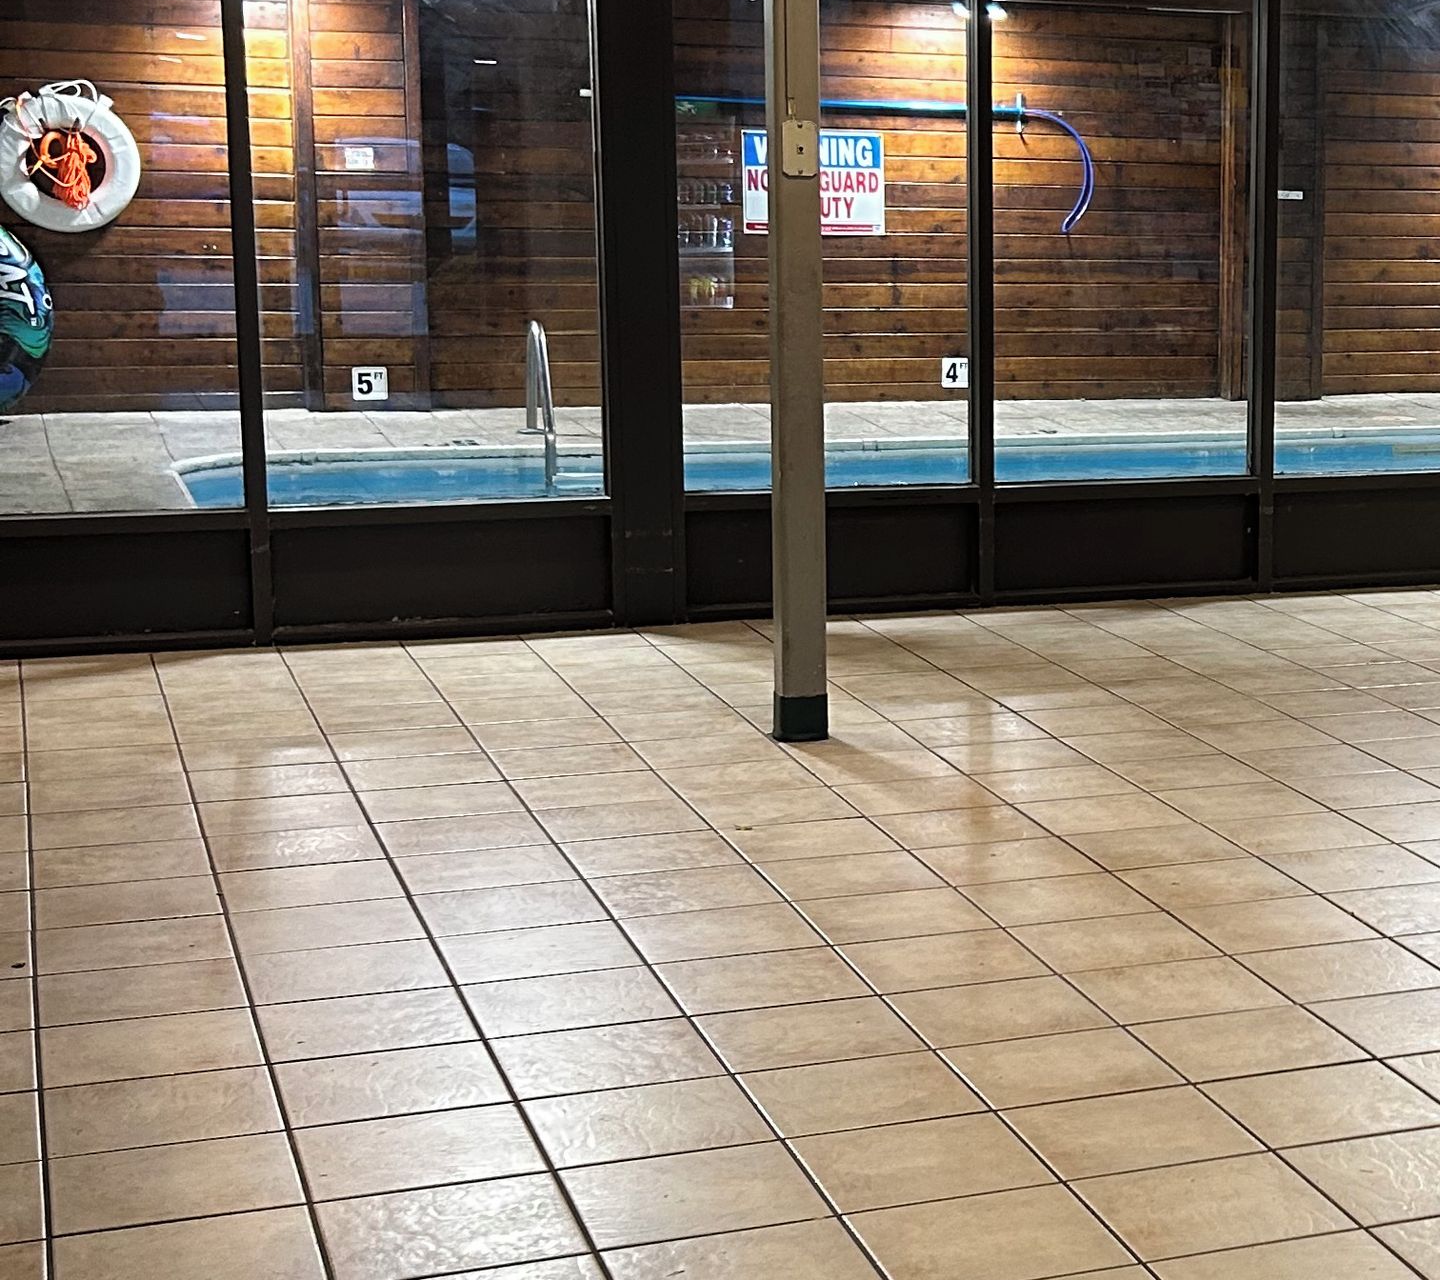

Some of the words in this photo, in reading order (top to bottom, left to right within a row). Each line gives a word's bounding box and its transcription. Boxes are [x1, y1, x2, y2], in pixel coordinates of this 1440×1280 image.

[357, 372, 373, 395] 5
[374, 371, 383, 380] FT
[945, 362, 959, 383] 4
